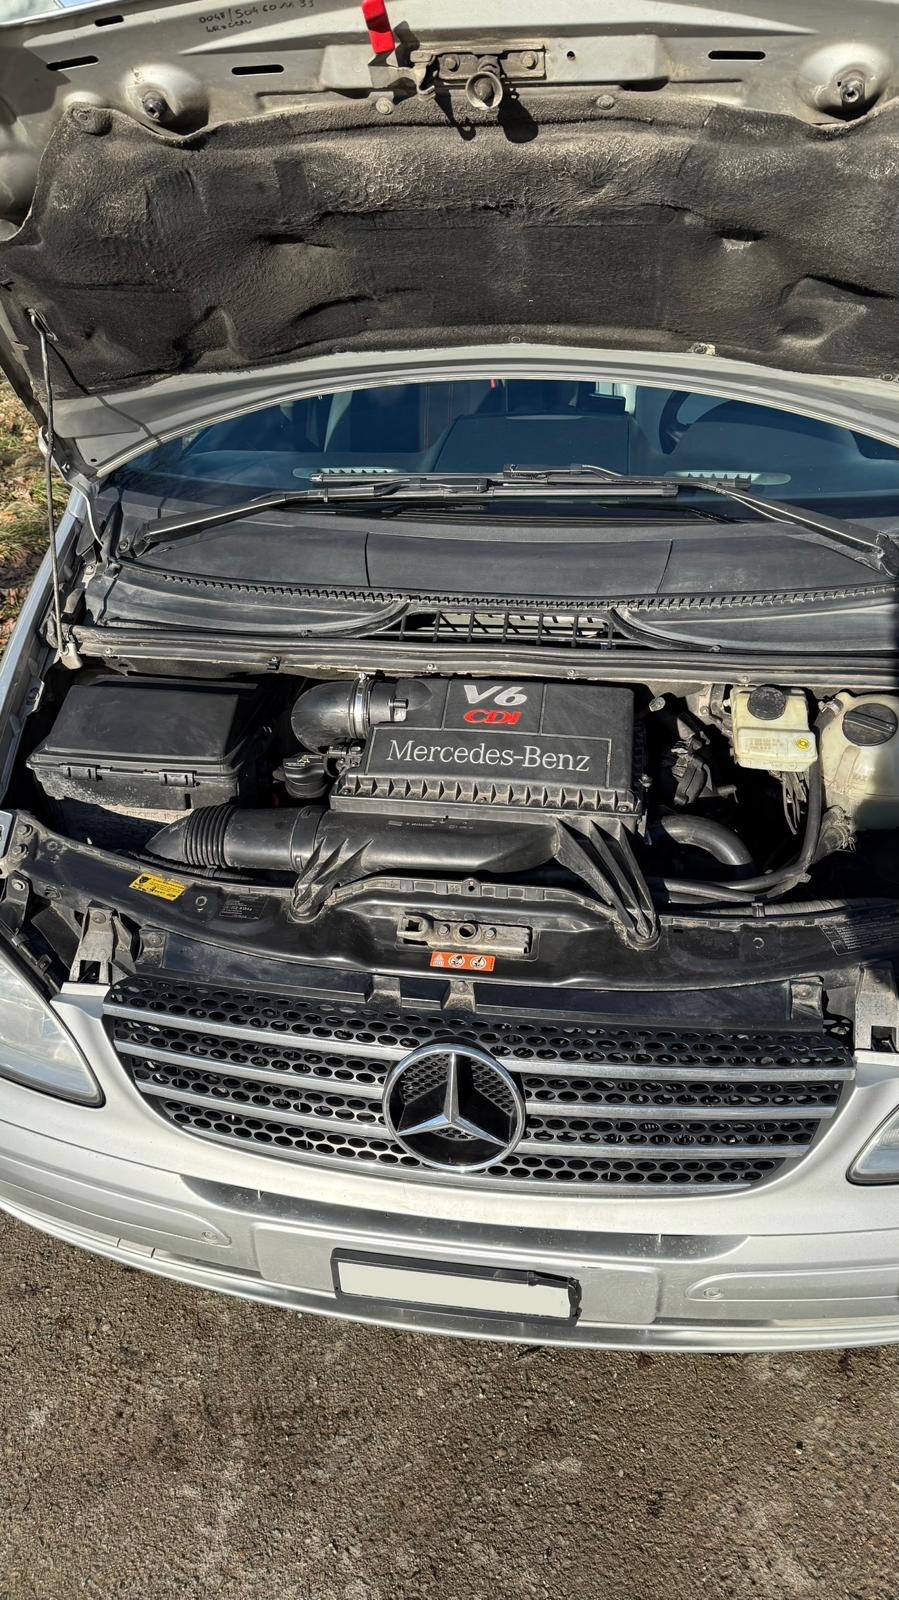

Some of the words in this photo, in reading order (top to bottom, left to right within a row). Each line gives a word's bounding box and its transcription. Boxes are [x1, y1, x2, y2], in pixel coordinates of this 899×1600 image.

[463, 684, 528, 706] V6
[463, 709, 523, 725] CDI
[386, 739, 591, 772] Mercedes-Benz
